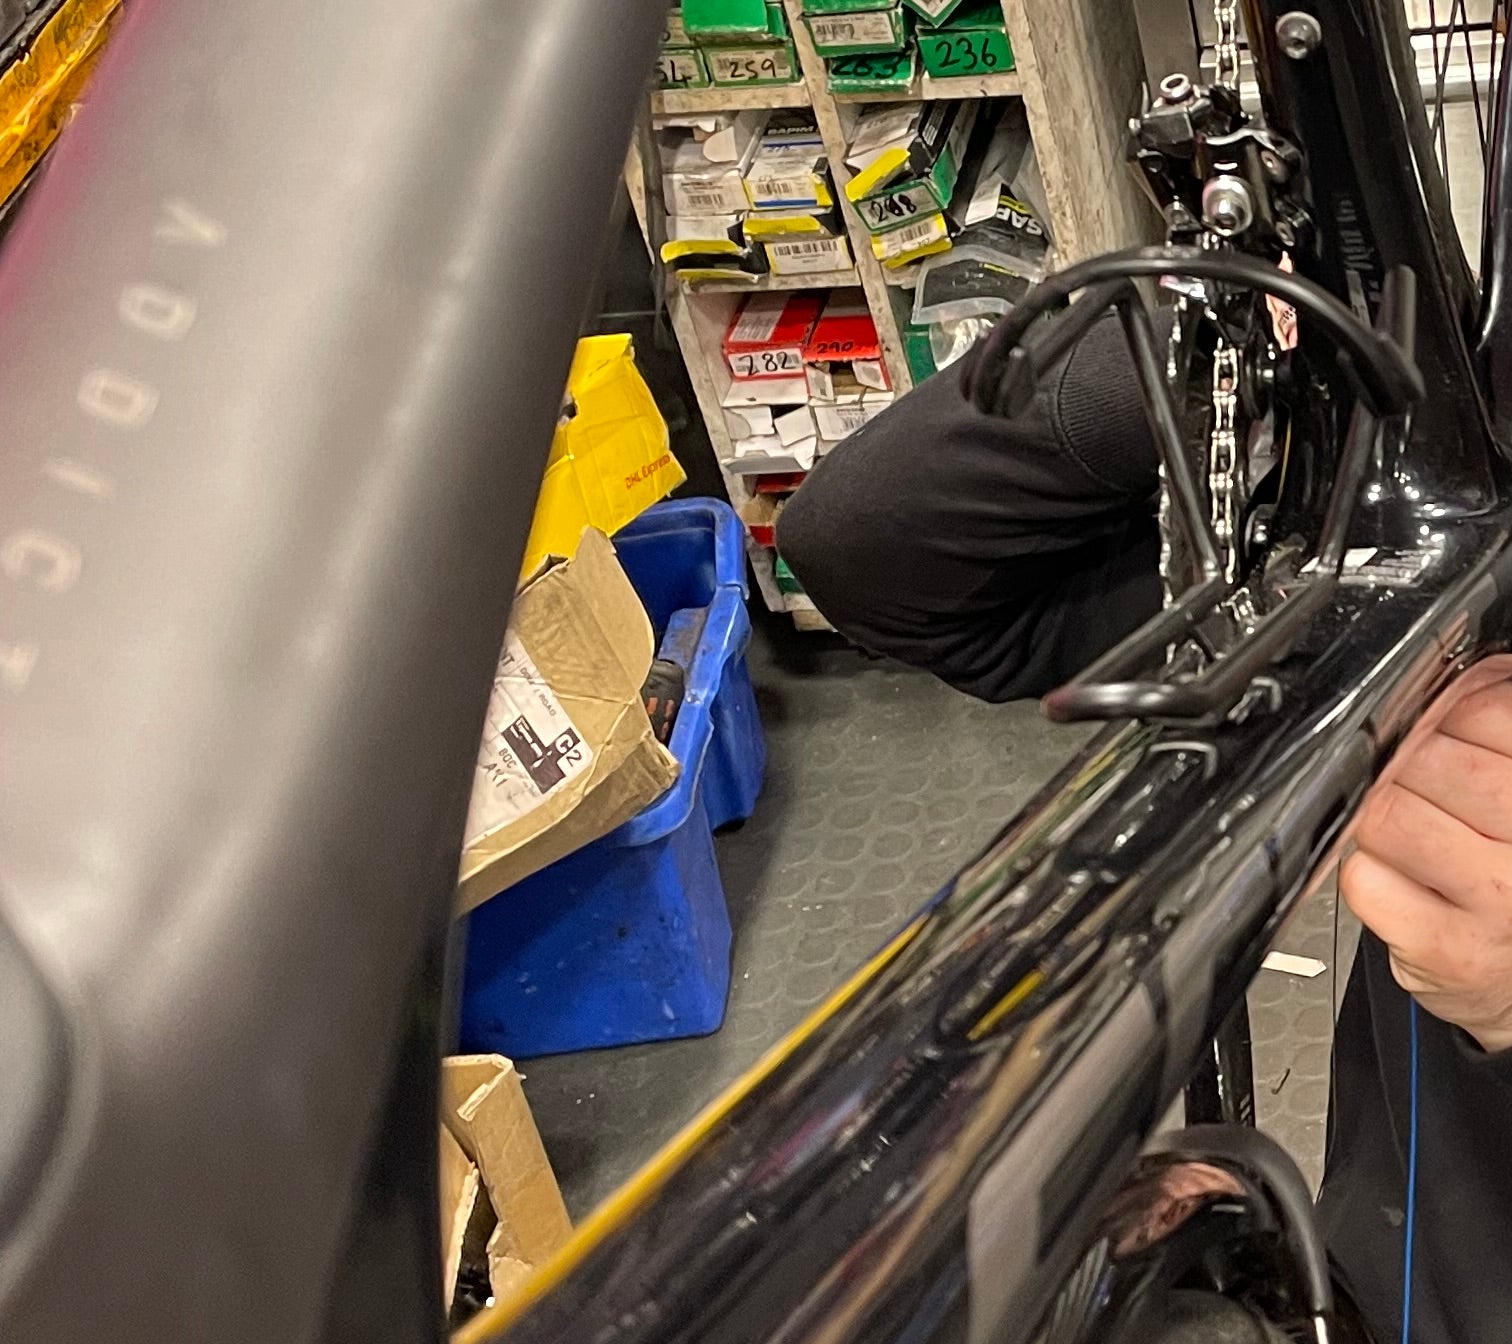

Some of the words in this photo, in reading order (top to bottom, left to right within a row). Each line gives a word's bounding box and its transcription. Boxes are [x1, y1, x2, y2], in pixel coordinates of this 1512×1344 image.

[936, 38, 998, 70] 236
[655, 59, 692, 84] 54
[729, 60, 777, 78] 259
[738, 351, 794, 376] 282
